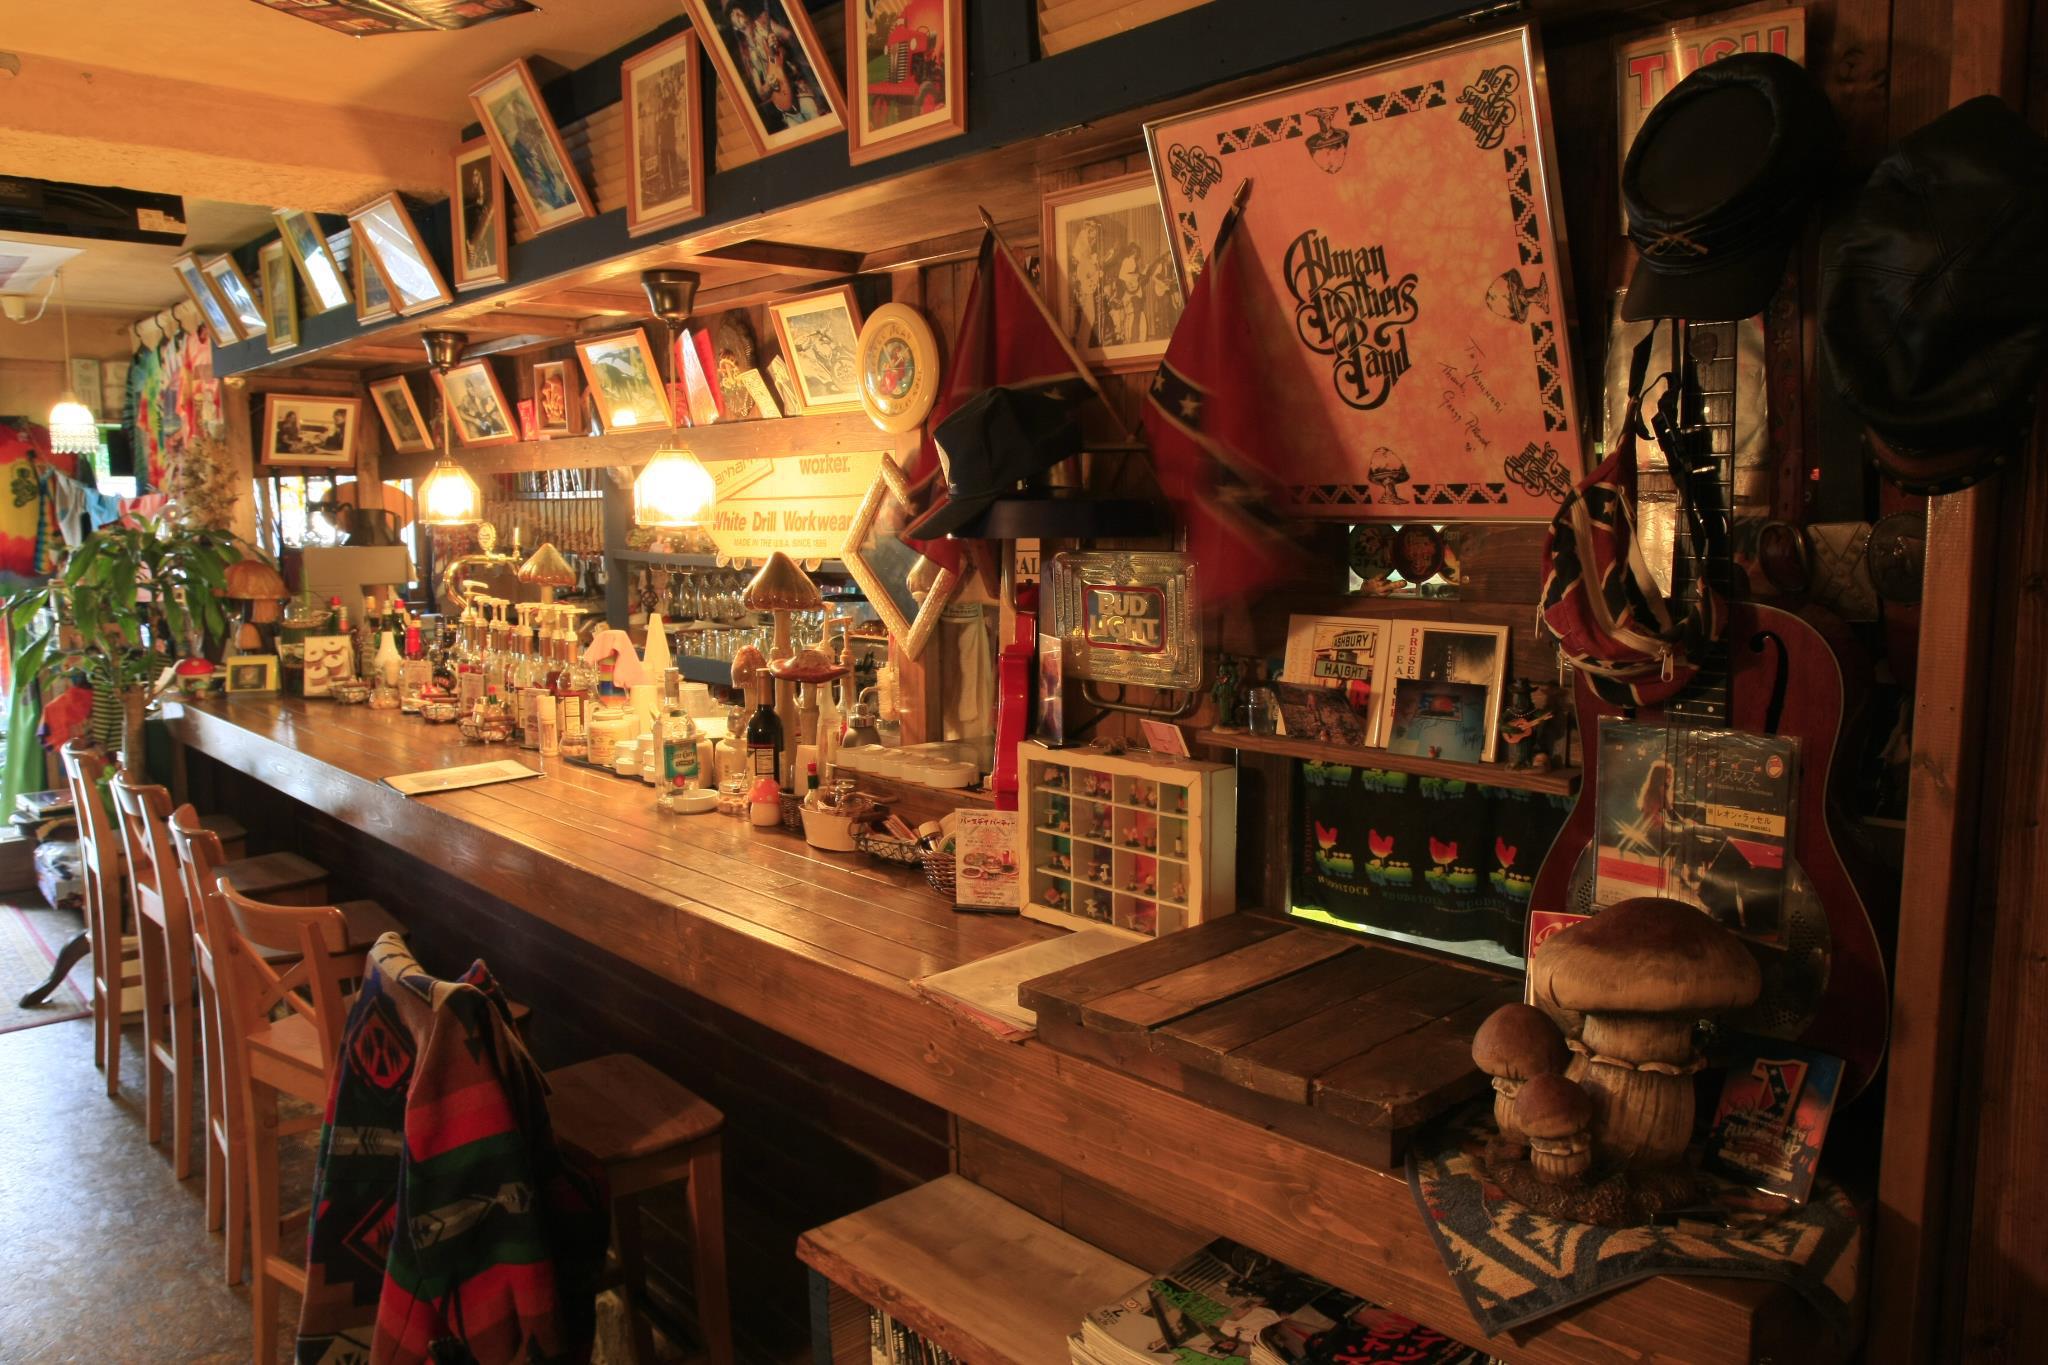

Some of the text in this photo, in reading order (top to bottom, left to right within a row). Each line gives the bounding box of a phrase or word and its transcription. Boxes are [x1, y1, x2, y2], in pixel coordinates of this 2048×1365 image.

[713, 509, 853, 531] White Drill Workwear
[1098, 592, 1148, 616] BUD
[1089, 614, 1160, 641] LIGHT
[1334, 633, 1370, 648] ASHBURY
[1324, 663, 1364, 678] HAIGHT
[1717, 809, 1772, 825] レオン・ラッセル
